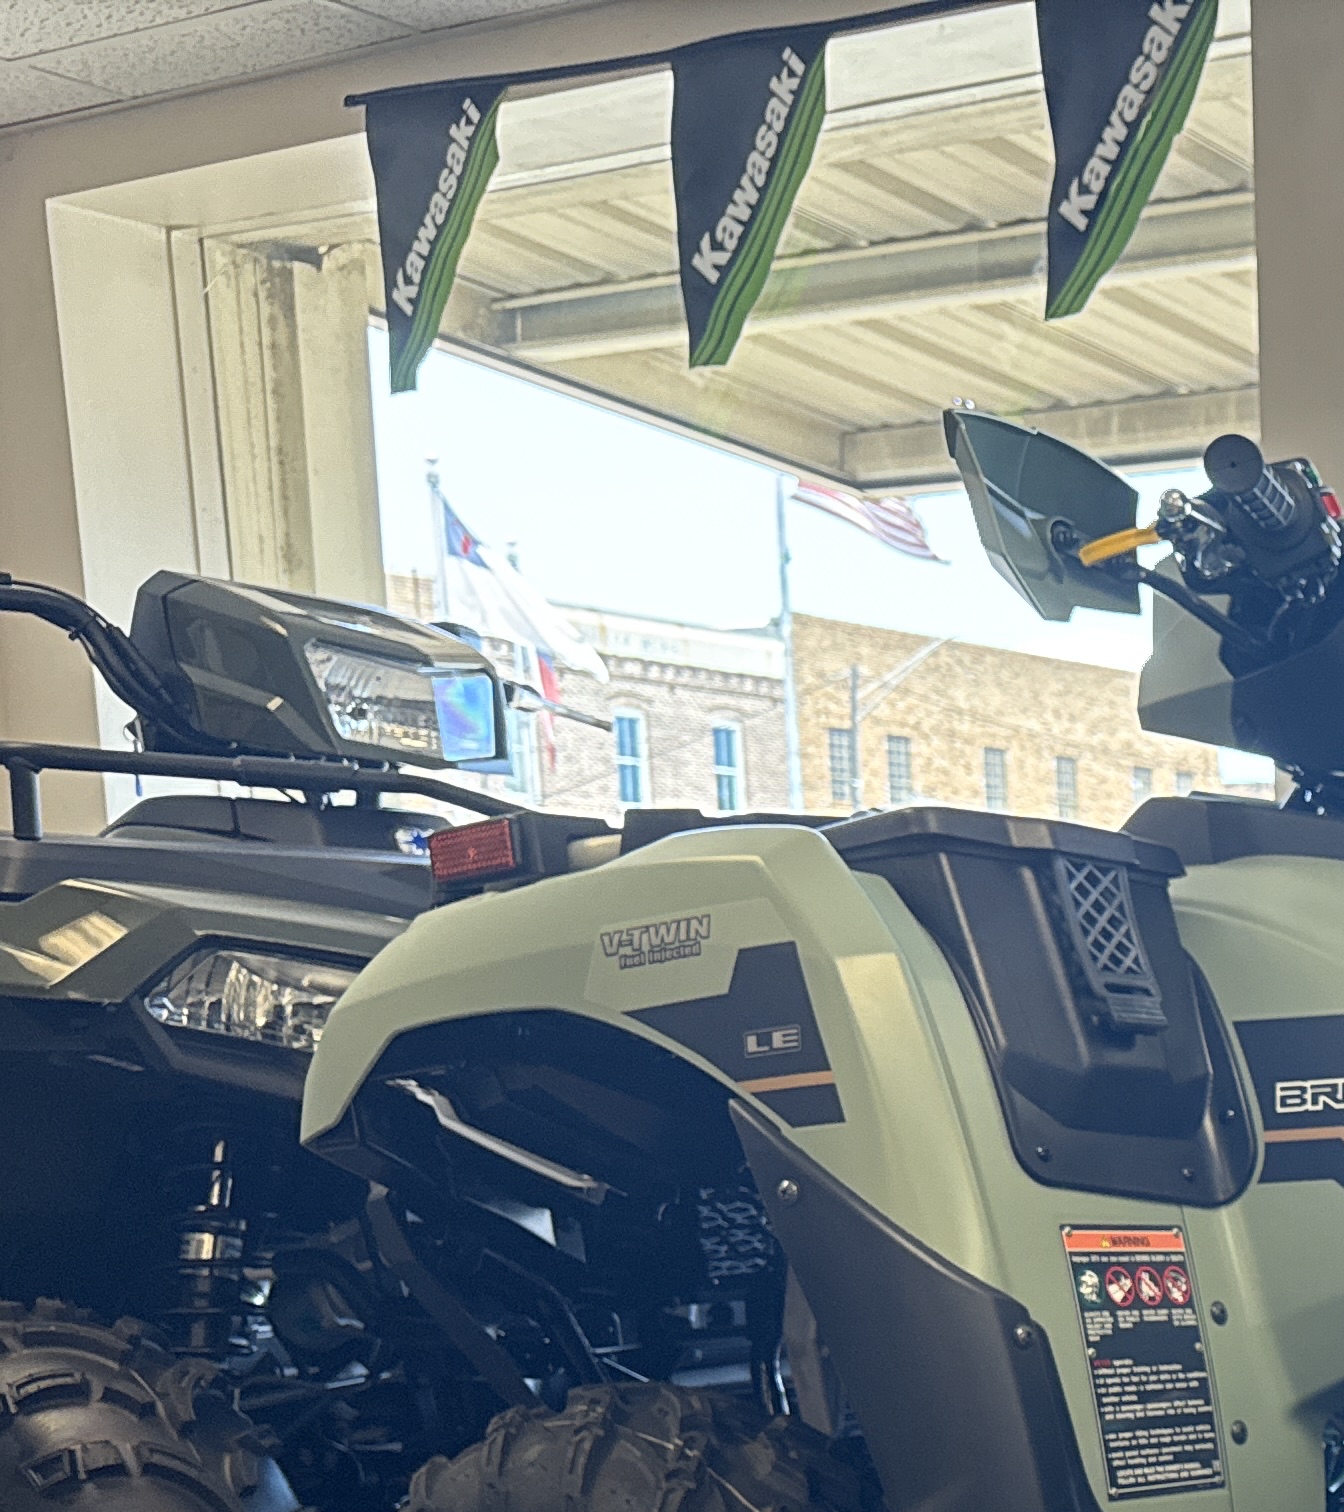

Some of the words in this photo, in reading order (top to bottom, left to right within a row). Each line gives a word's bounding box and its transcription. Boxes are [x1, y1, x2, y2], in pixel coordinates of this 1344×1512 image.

[392, 98, 481, 316] Kawasaki
[691, 46, 806, 285] Kawasaki
[600, 914, 711, 957] V-TWIN
[746, 1028, 799, 1054] LE
